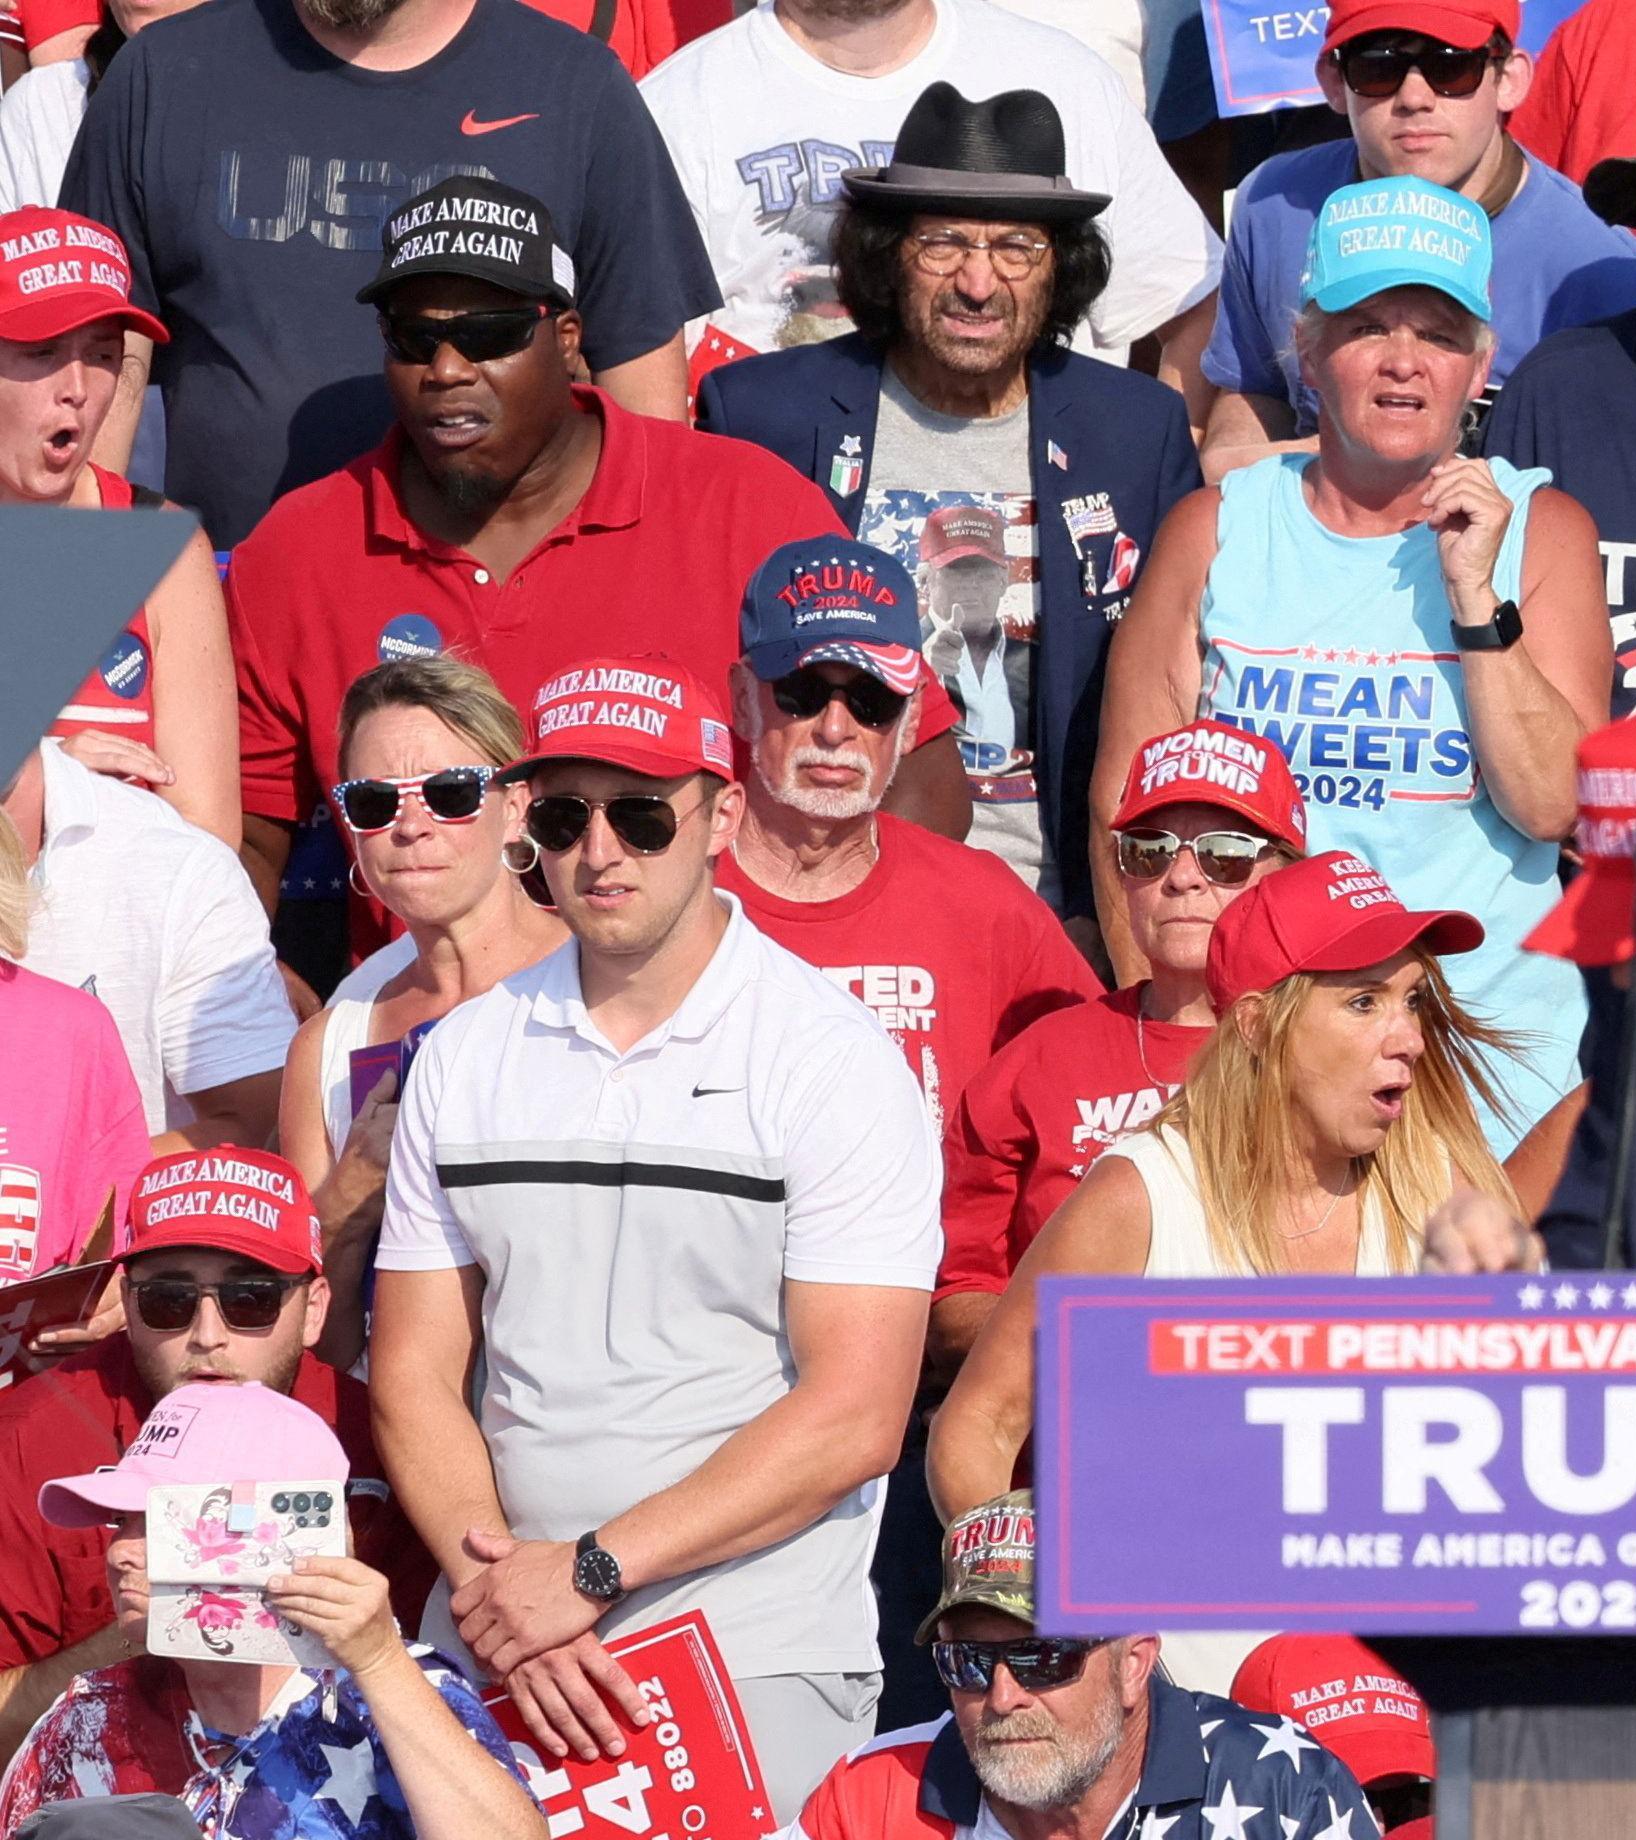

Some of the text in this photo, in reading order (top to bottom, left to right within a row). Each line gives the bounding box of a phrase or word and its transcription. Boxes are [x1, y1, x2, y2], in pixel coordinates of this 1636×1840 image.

[215, 149, 499, 252] US
[390, 197, 540, 245] MAKE AMERICA
[1327, 190, 1482, 242] MAKE AMERICA
[1, 224, 127, 267] MAKE AMERICA
[391, 230, 525, 269] GREAT AGAIN
[1339, 224, 1472, 266] GREAT AGAIN
[18, 260, 127, 298] GREAT AGAI
[776, 565, 898, 609] TRUMP
[813, 594, 860, 610] 2024
[796, 609, 877, 626] SAVE AMERICA!
[533, 667, 683, 711] MAKE AMERICA
[1234, 665, 1434, 721] MEAN
[538, 701, 668, 739] GREAT AGAIN
[1143, 728, 1267, 774] WOMEN
[1140, 755, 1259, 796] TRUMP
[1349, 888, 1399, 910] GREA
[138, 1157, 295, 1205] MAKE AMERICA
[146, 1190, 281, 1232] GREAT AGAIN
[1172, 1323, 1317, 1371] TEXT
[1281, 1531, 1403, 1569] MAKE
[1412, 1531, 1607, 1569] AMERICA
[1290, 1674, 1422, 1710] MAKE AMERICA
[1305, 1697, 1419, 1728] GREAT AGAIN
[638, 1675, 697, 1793] 88022
